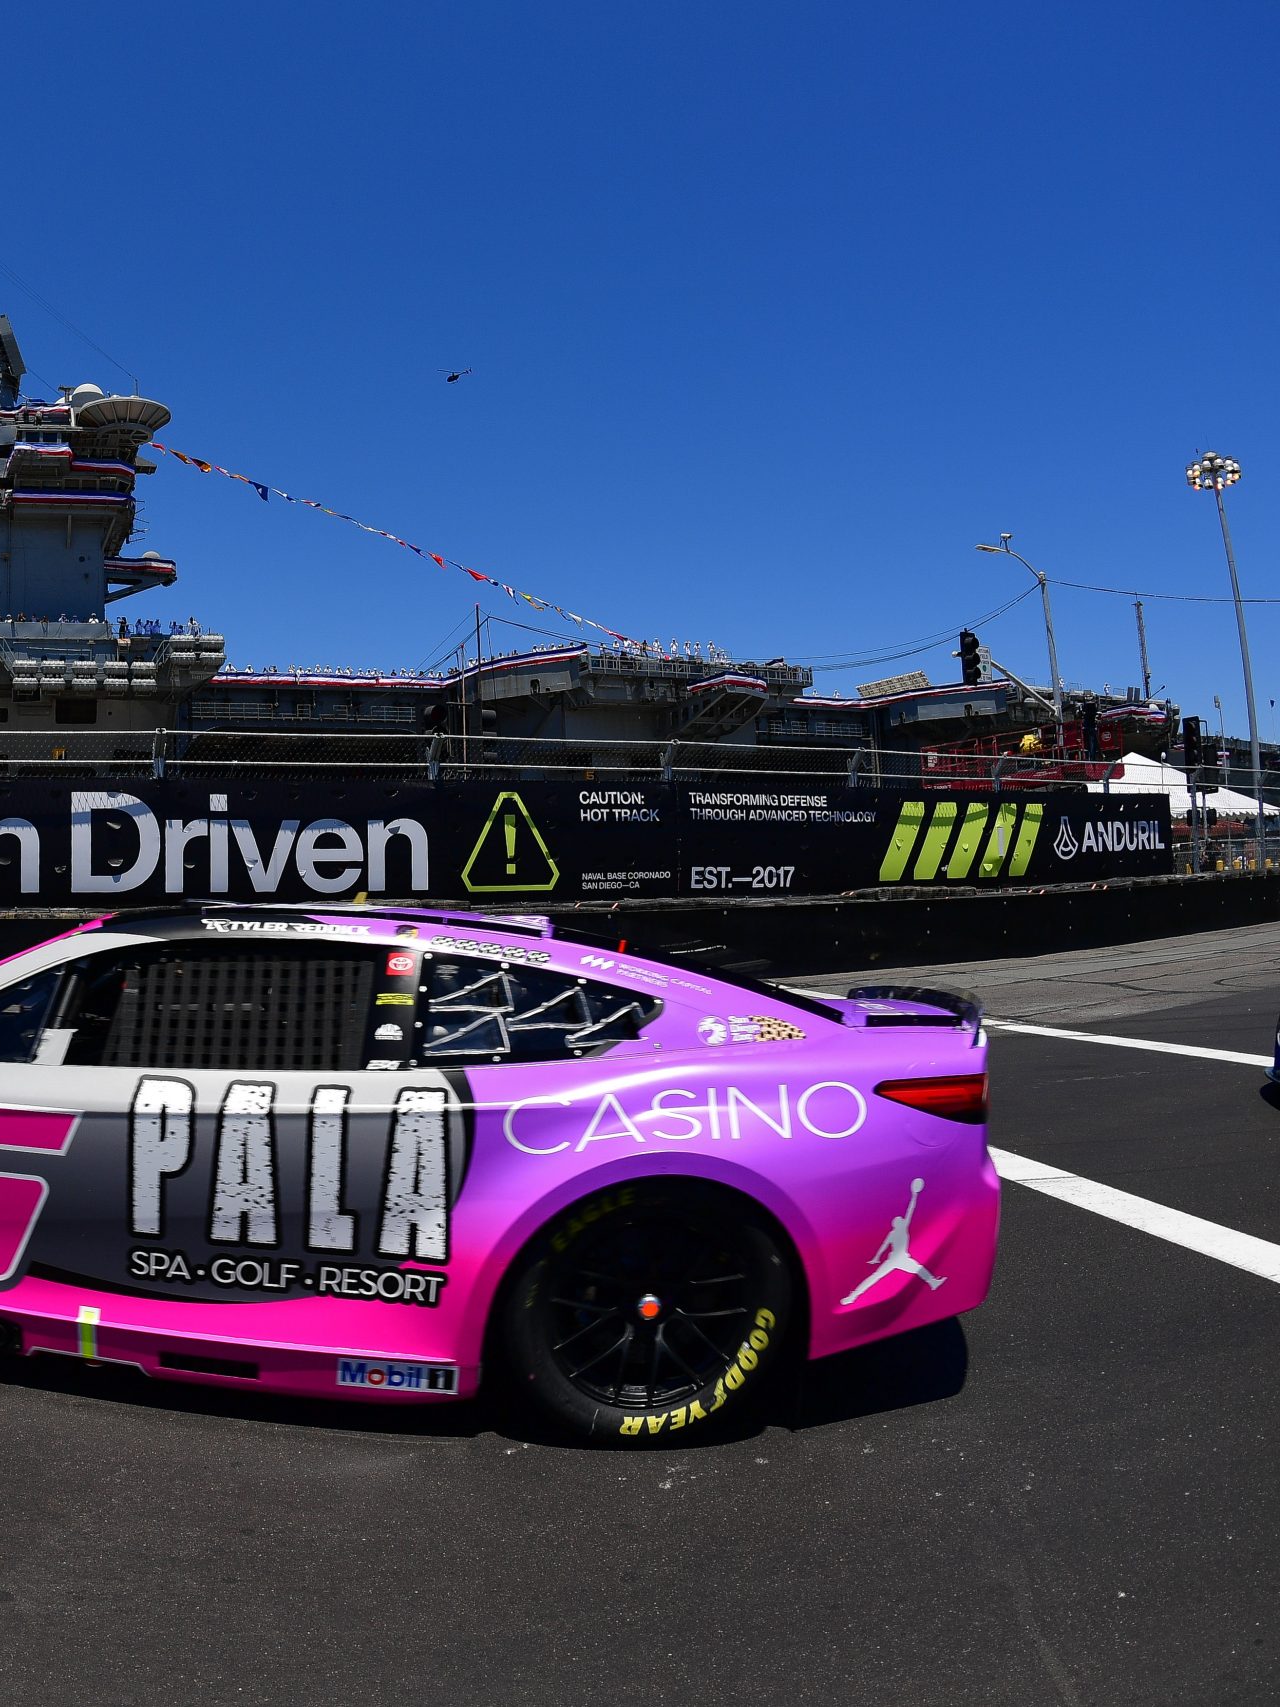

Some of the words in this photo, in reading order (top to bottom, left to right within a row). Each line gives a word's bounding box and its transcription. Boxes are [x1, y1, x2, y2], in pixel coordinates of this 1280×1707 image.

[579, 790, 645, 805] CAUTION:
[688, 791, 778, 807] TRANSFORMING
[779, 794, 827, 808] DEFENSE
[580, 808, 610, 822] HOT
[612, 808, 660, 822] TRACK
[689, 807, 746, 821] THROUGH
[748, 808, 807, 822] ADVANCED
[808, 810, 877, 823] TECHNOLOGY
[70, 790, 429, 895] Driven
[1081, 820, 1165, 853] ANDURIL
[581, 872, 606, 881] NAVAL
[607, 872, 627, 880] BASE
[627, 870, 671, 880] CORONADO
[581, 881, 598, 890] SAN
[230, 920, 289, 933] TYLER
[289, 922, 373, 935] REDDICK
[502, 1081, 868, 1155] CASINO
[131, 1077, 449, 1261] PALA
[131, 1250, 192, 1281] SPA
[210, 1258, 301, 1288] GOLF
[319, 1265, 446, 1304] RESORT
[339, 1361, 423, 1389] Mobil
[434, 1367, 447, 1389] 1
[619, 1307, 776, 1436] GOODYEAR
